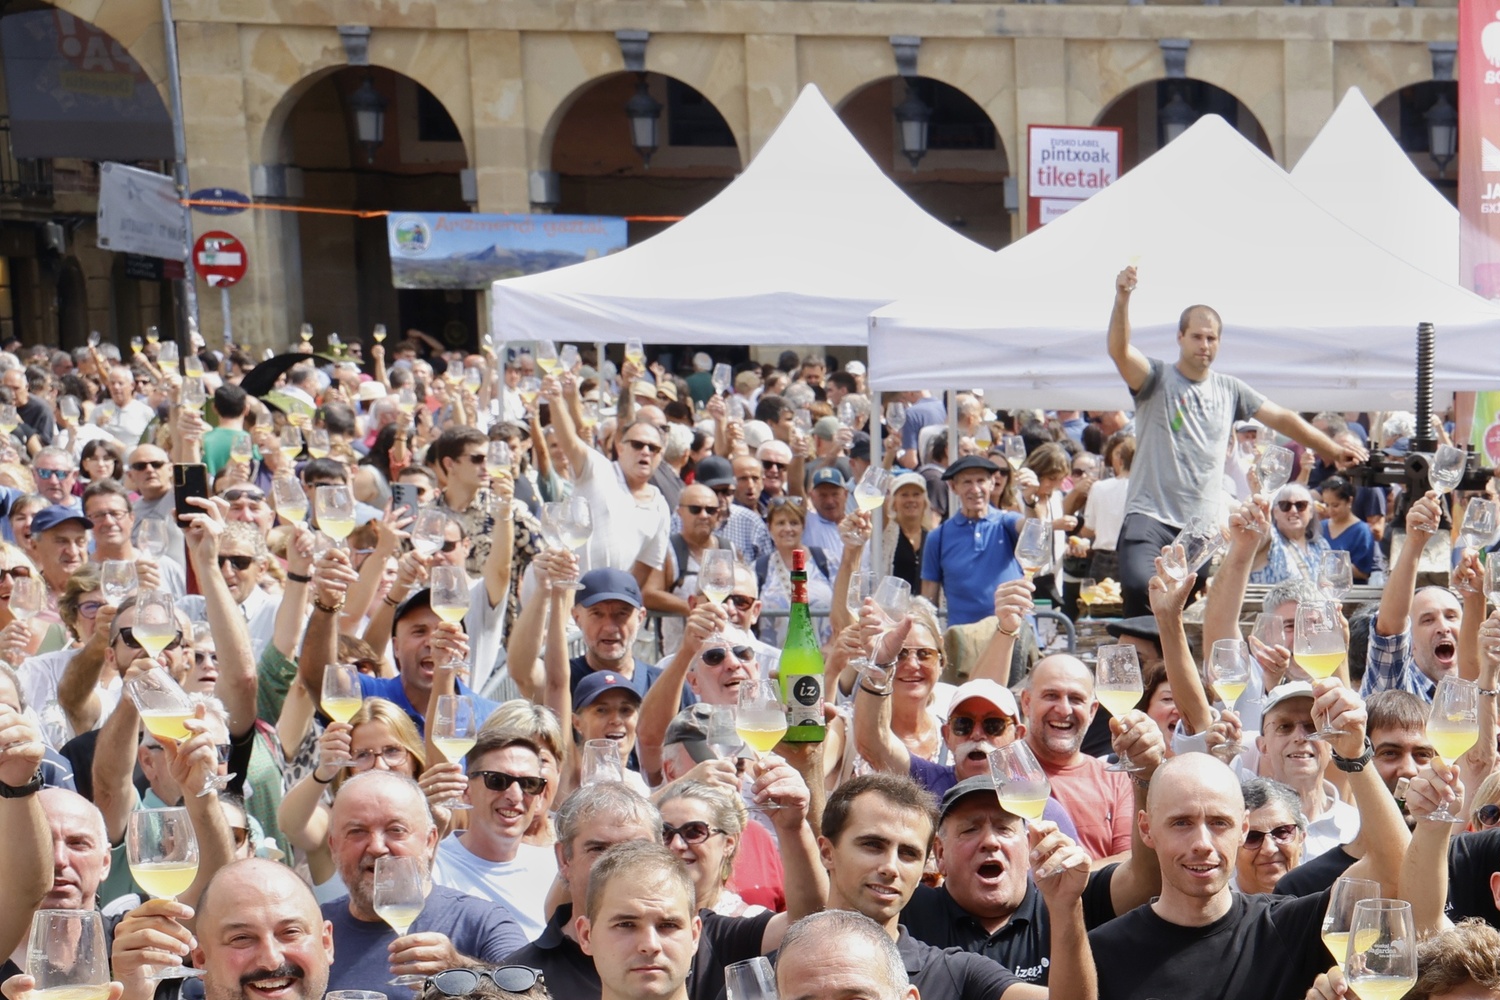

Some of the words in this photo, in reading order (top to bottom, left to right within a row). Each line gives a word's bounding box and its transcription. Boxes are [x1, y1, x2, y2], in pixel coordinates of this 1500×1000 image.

[1041, 147, 1110, 164] pintxoak
[1038, 166, 1111, 189] tiketak
[799, 682, 817, 697] iz
